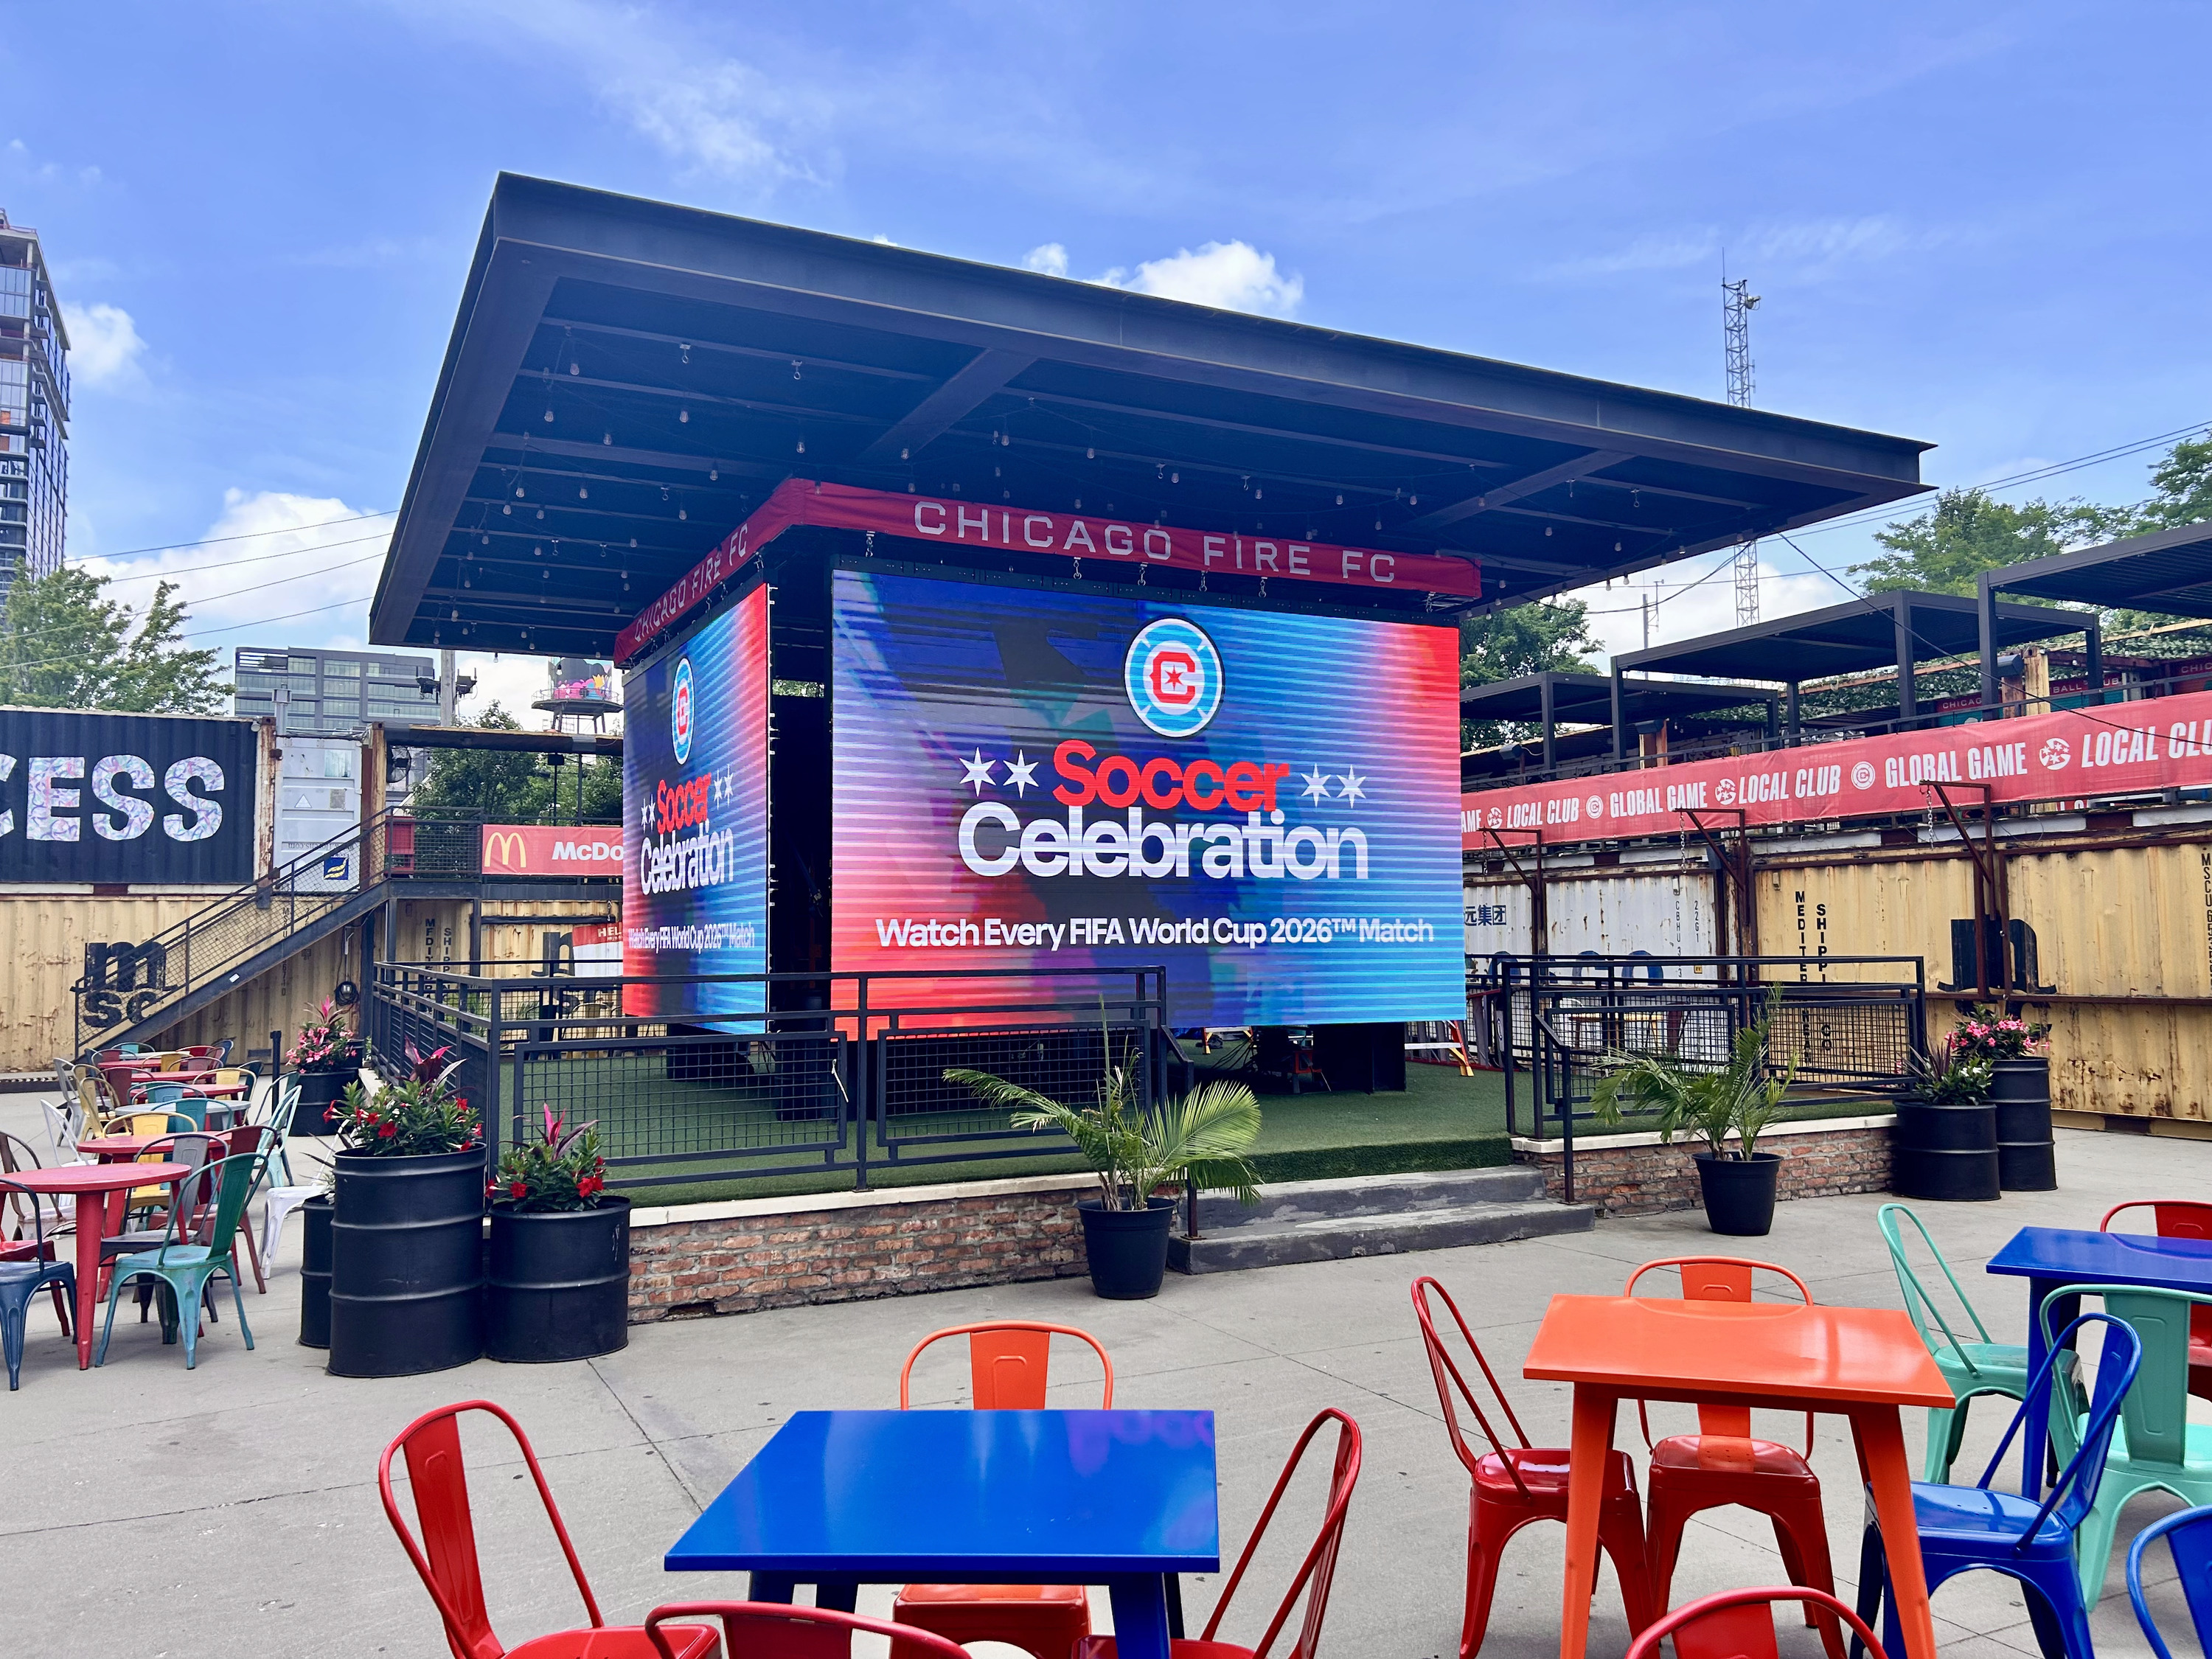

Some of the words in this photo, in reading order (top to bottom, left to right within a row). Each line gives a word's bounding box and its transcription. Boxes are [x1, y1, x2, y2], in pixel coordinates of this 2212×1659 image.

[914, 501, 1172, 561] CHICAGO
[1203, 535, 1311, 576] FIRE
[1342, 549, 1395, 583] FC
[634, 579, 686, 642] CHICAGO
[692, 554, 722, 599] FIRE
[728, 523, 748, 566] FC
[657, 772, 712, 835] Soccer
[1051, 738, 1290, 813] Soccer
[1506, 801, 1543, 829] LOCAL
[1546, 797, 1580, 824] CLUB
[1609, 786, 1663, 818] GLOBAL
[1666, 781, 1708, 812] GAME
[1738, 771, 1790, 804] LOCAL
[1795, 764, 1841, 799] CLUB
[1885, 750, 1962, 788] GLOBAL
[1967, 742, 2028, 781] GAME
[2081, 726, 2159, 768] LOCAL
[640, 818, 734, 896] Celebration
[958, 800, 1368, 880] Celebration
[2201, 852, 2212, 907] MSCU
[644, 927, 660, 954] Every
[671, 925, 689, 950] World
[689, 924, 703, 955] Cup
[728, 921, 755, 949] Match
[875, 917, 981, 948] Watch
[984, 919, 1067, 952] Every
[1070, 919, 1126, 945] FIFA
[1129, 917, 1210, 945] World
[1214, 917, 1267, 950] Cup
[1360, 917, 1434, 944] Match
